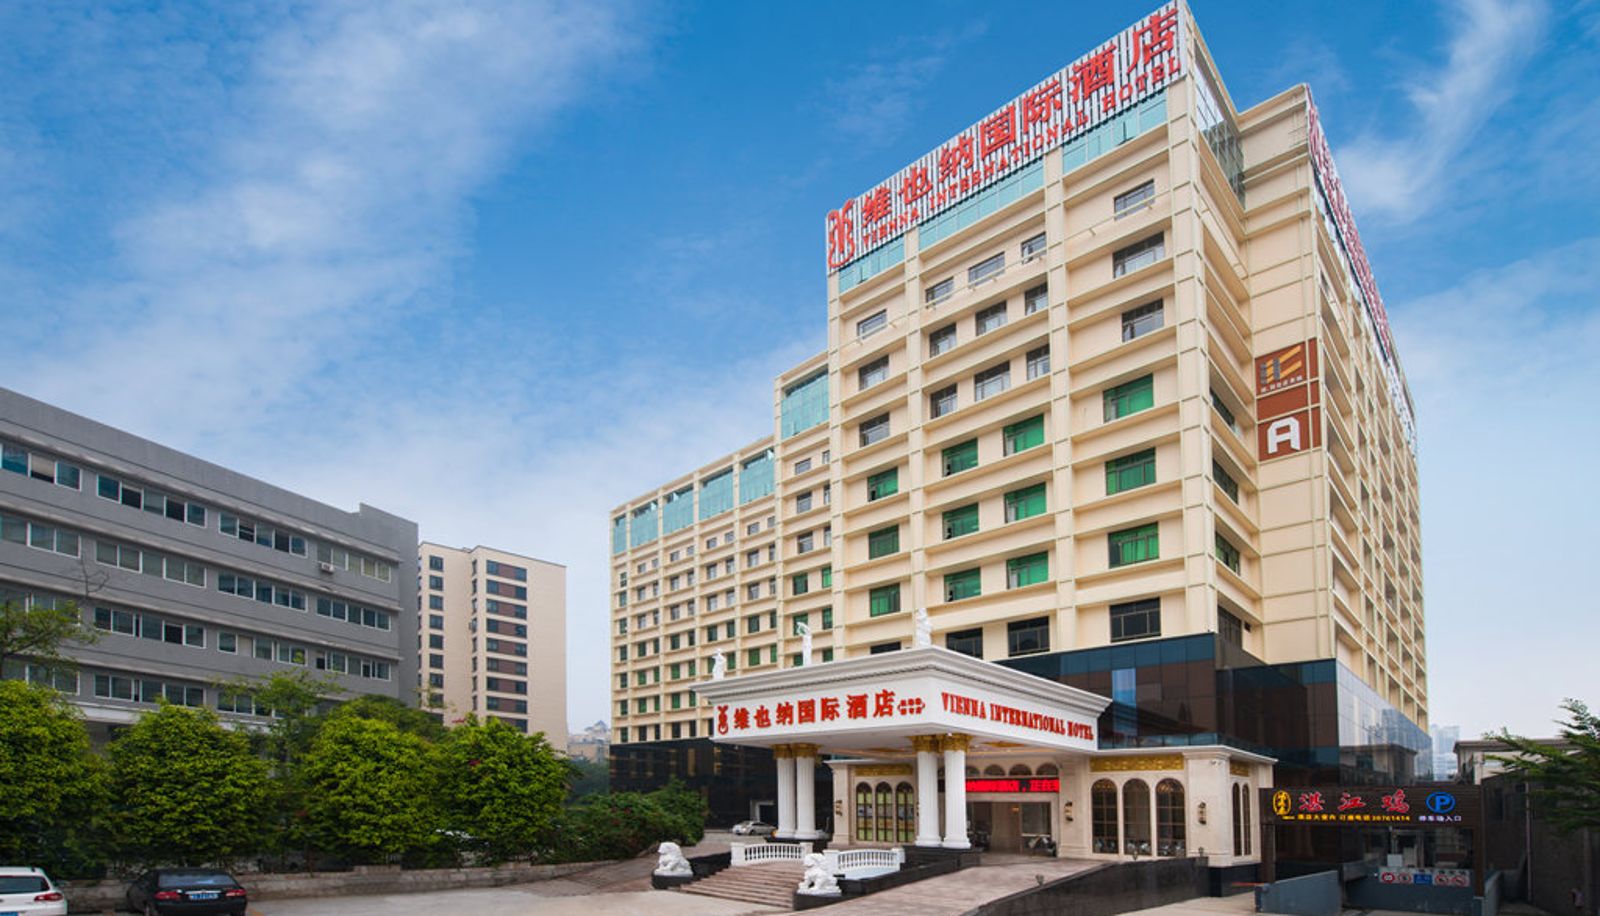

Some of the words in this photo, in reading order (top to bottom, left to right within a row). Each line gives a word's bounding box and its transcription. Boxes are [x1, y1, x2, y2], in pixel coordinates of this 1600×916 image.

[862, 8, 1179, 228] 维也纳国际酒店
[862, 208, 920, 248] VIENNA
[929, 110, 1089, 210] INTERNATIONAL
[1102, 56, 1182, 113] HOTEL
[1267, 416, 1300, 454] A
[733, 689, 896, 730] 维也纳国际酒店
[941, 692, 987, 719] VIENNA
[990, 703, 1066, 735] INTERNATIONAL
[1067, 720, 1095, 740] HOTEL
